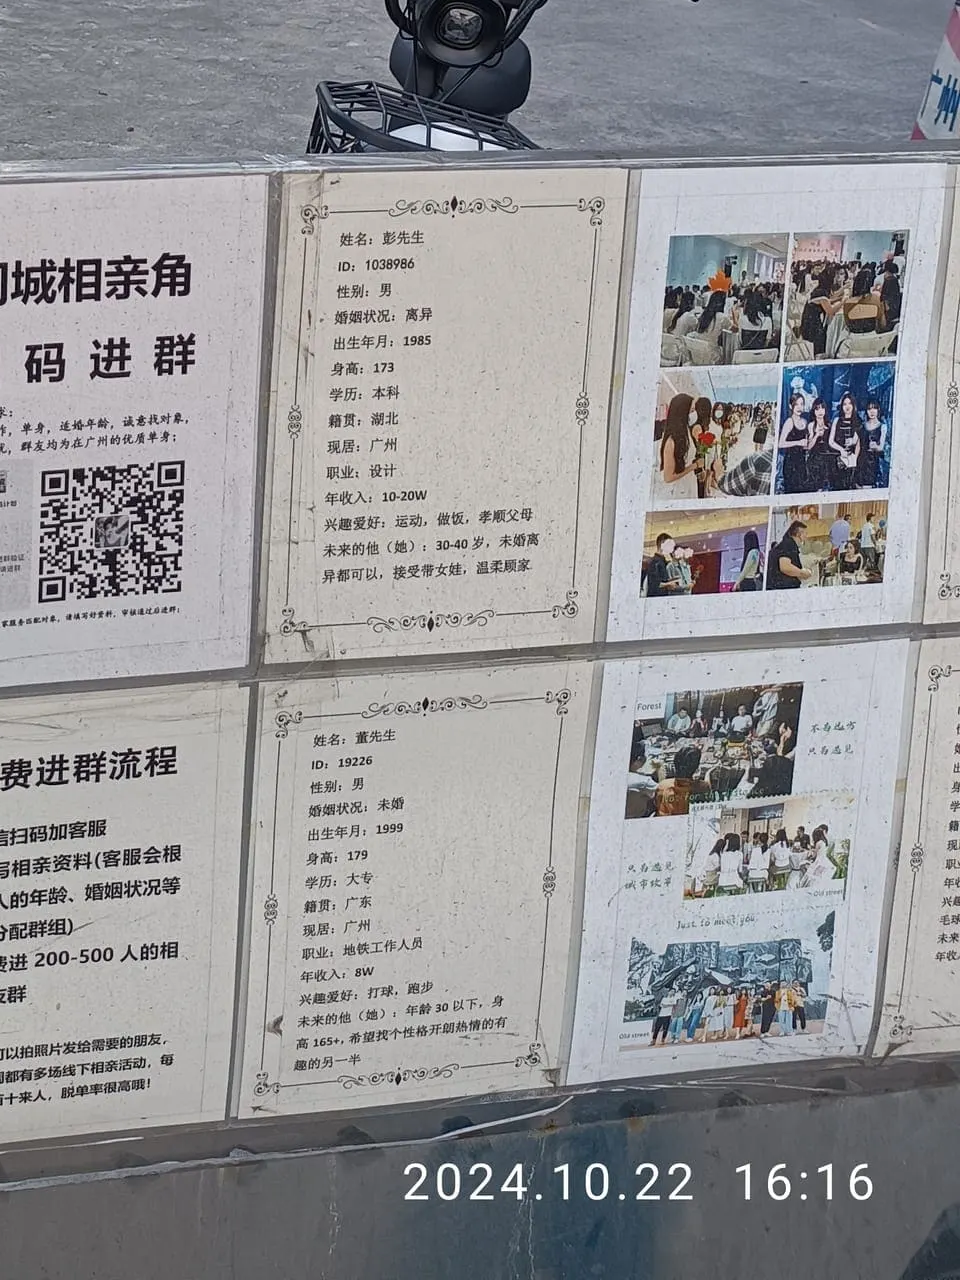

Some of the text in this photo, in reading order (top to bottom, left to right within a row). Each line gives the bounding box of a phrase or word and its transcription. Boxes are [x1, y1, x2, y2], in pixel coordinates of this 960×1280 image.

[339, 230, 424, 247] 姓名：彭先生
[338, 257, 415, 272] ID：1038986
[334, 308, 433, 325] 婚姻状况：离异
[333, 335, 431, 351] 出生年月：1985
[331, 362, 394, 377] 身高：173
[329, 385, 400, 401] 学历：本科
[328, 411, 399, 429] 籍贯：湖北
[327, 437, 397, 454] 现居：广州
[326, 463, 397, 480] 职业：设计
[325, 489, 428, 506] 年收入：10-20W
[637, 702, 662, 711] Forest
[313, 729, 396, 748] 姓名：董先生
[311, 756, 373, 771] ID：19226
[308, 797, 405, 818] 婚姻状况：未婚
[307, 823, 404, 842] 出生年月：1999
[306, 850, 368, 866] 身高：179
[305, 871, 374, 890] 学历：大专
[304, 895, 372, 914] 籍贯：广东
[302, 919, 371, 937] 现居：广州
[302, 937, 423, 960] 职业：地铁工作人员
[300, 966, 374, 983] 年收入：8W
[293, 1053, 361, 1071] 趣的另一半
